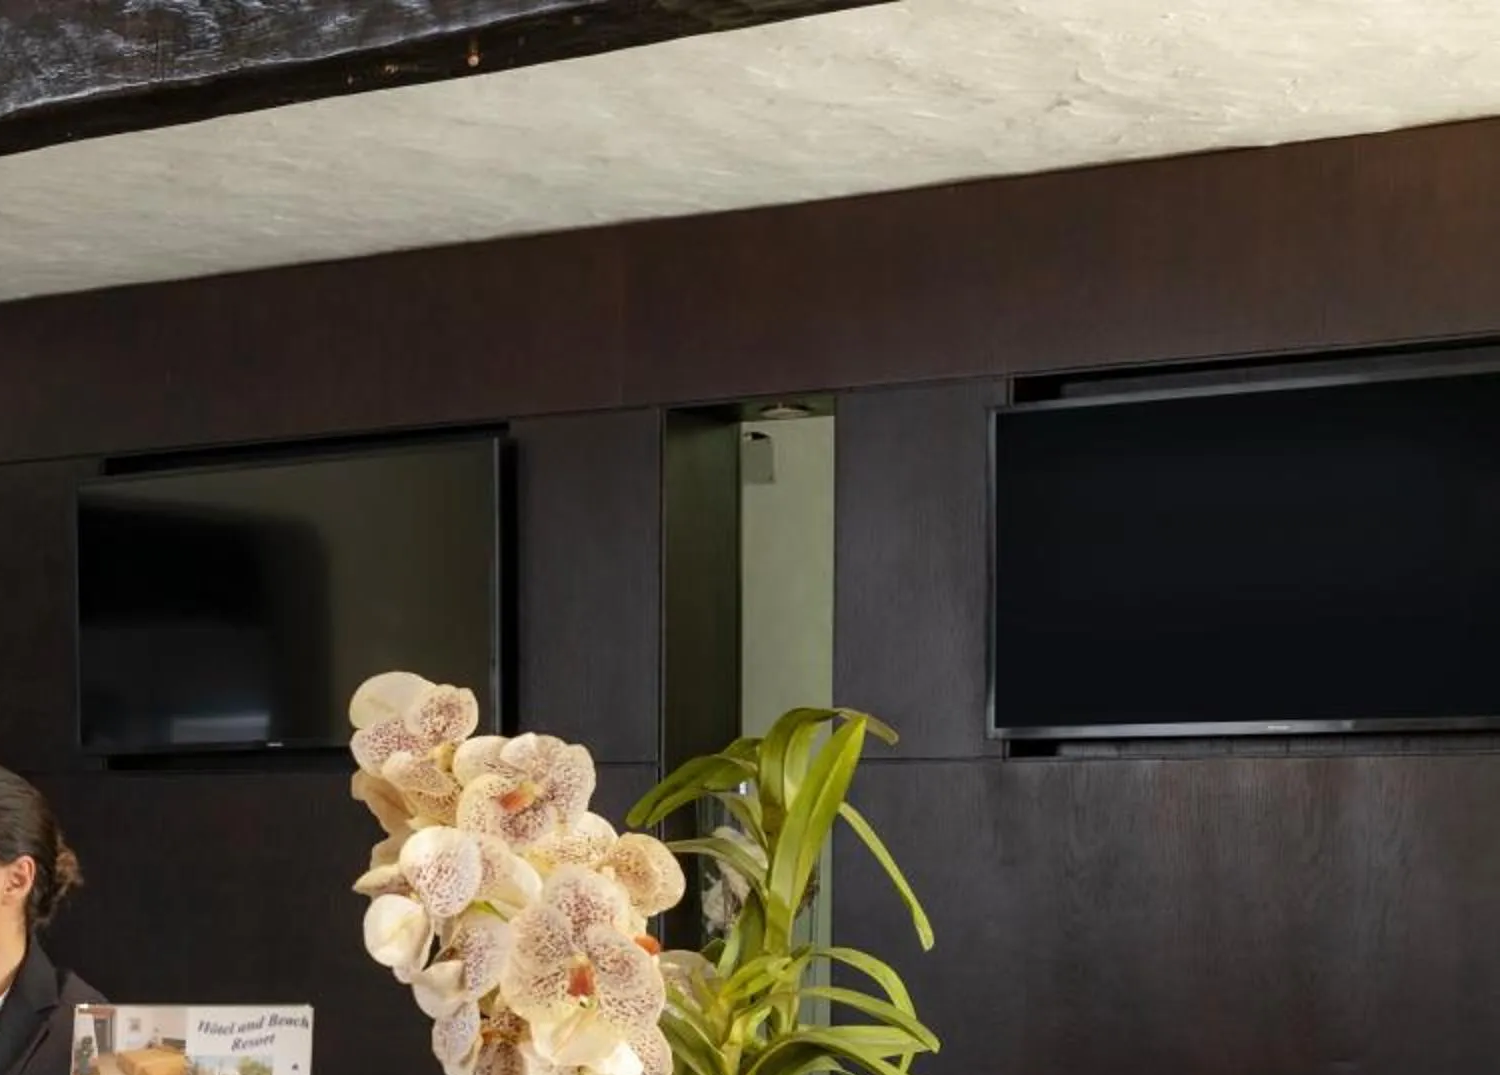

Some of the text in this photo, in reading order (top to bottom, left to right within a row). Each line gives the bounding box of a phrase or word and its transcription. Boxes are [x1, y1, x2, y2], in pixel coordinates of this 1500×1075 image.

[237, 1014, 265, 1033] and
[267, 1012, 309, 1030] Beach
[231, 1032, 276, 1052] Resort
